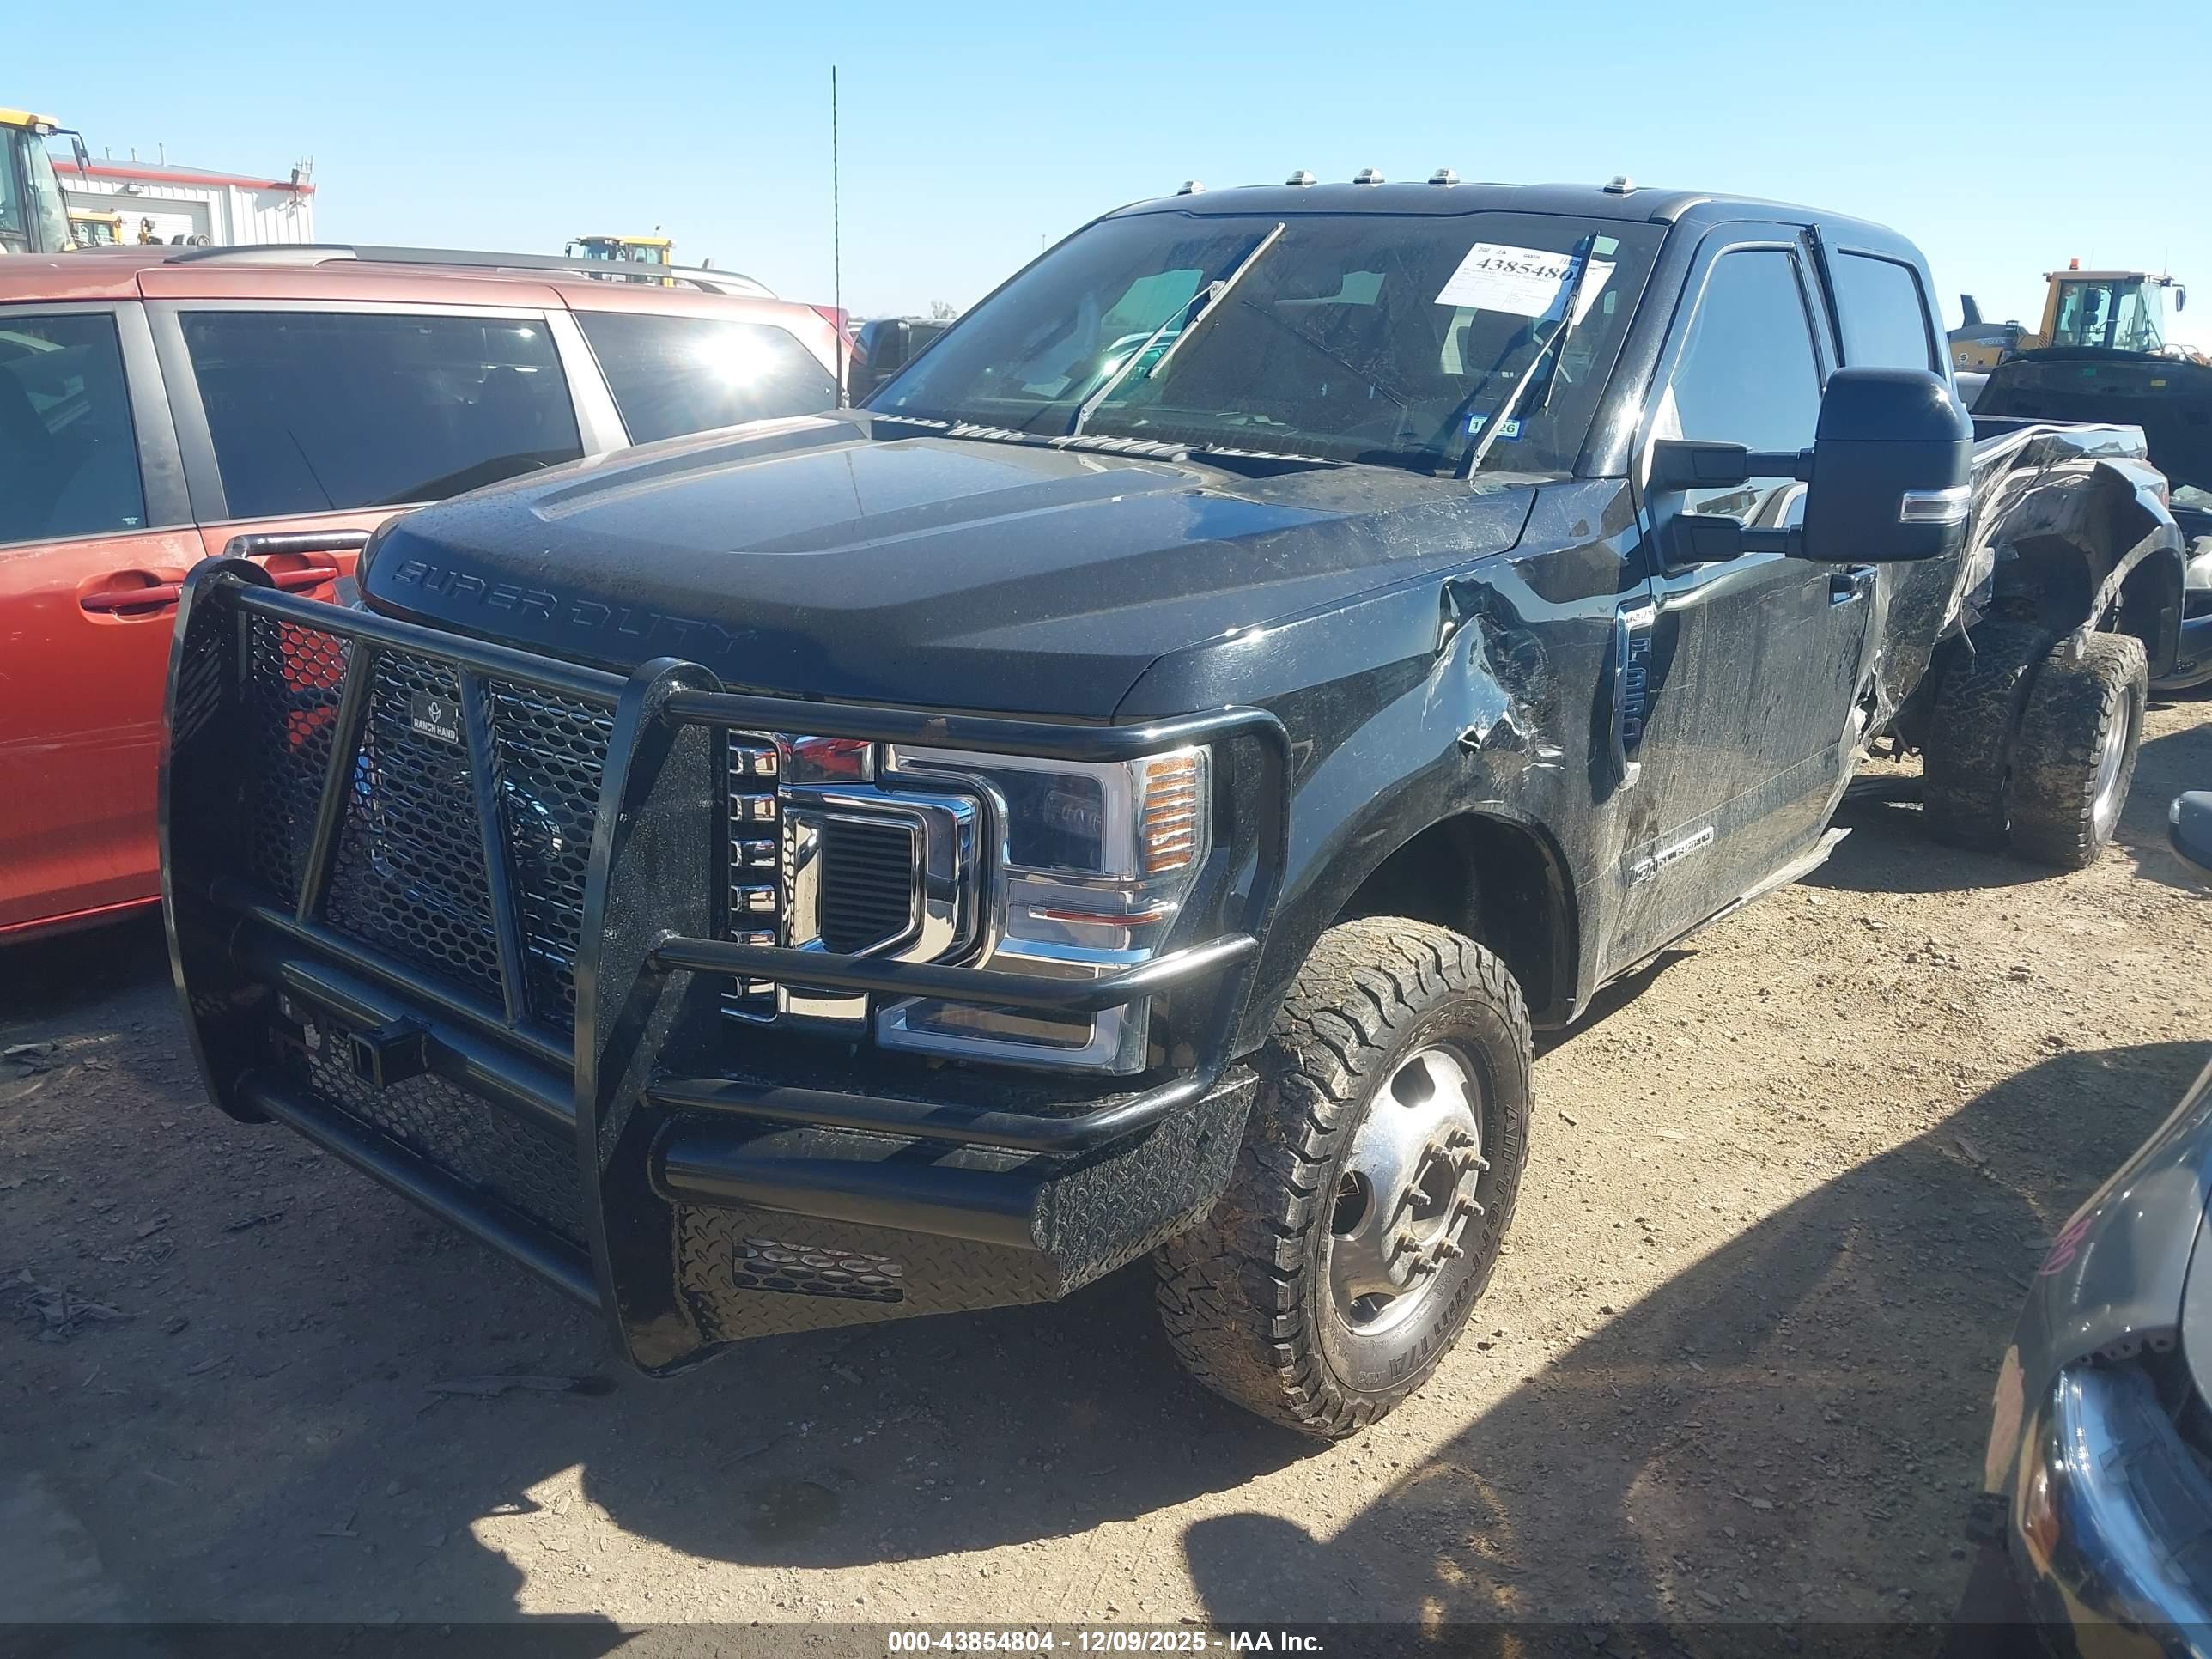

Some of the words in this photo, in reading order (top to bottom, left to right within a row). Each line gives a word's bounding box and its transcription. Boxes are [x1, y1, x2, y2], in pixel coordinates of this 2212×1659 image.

[1476, 258, 1577, 282] 4385480
[392, 560, 558, 619] SUPER
[572, 599, 757, 654] DUTY
[414, 718, 436, 734] RANCH
[437, 726, 455, 740] HAND
